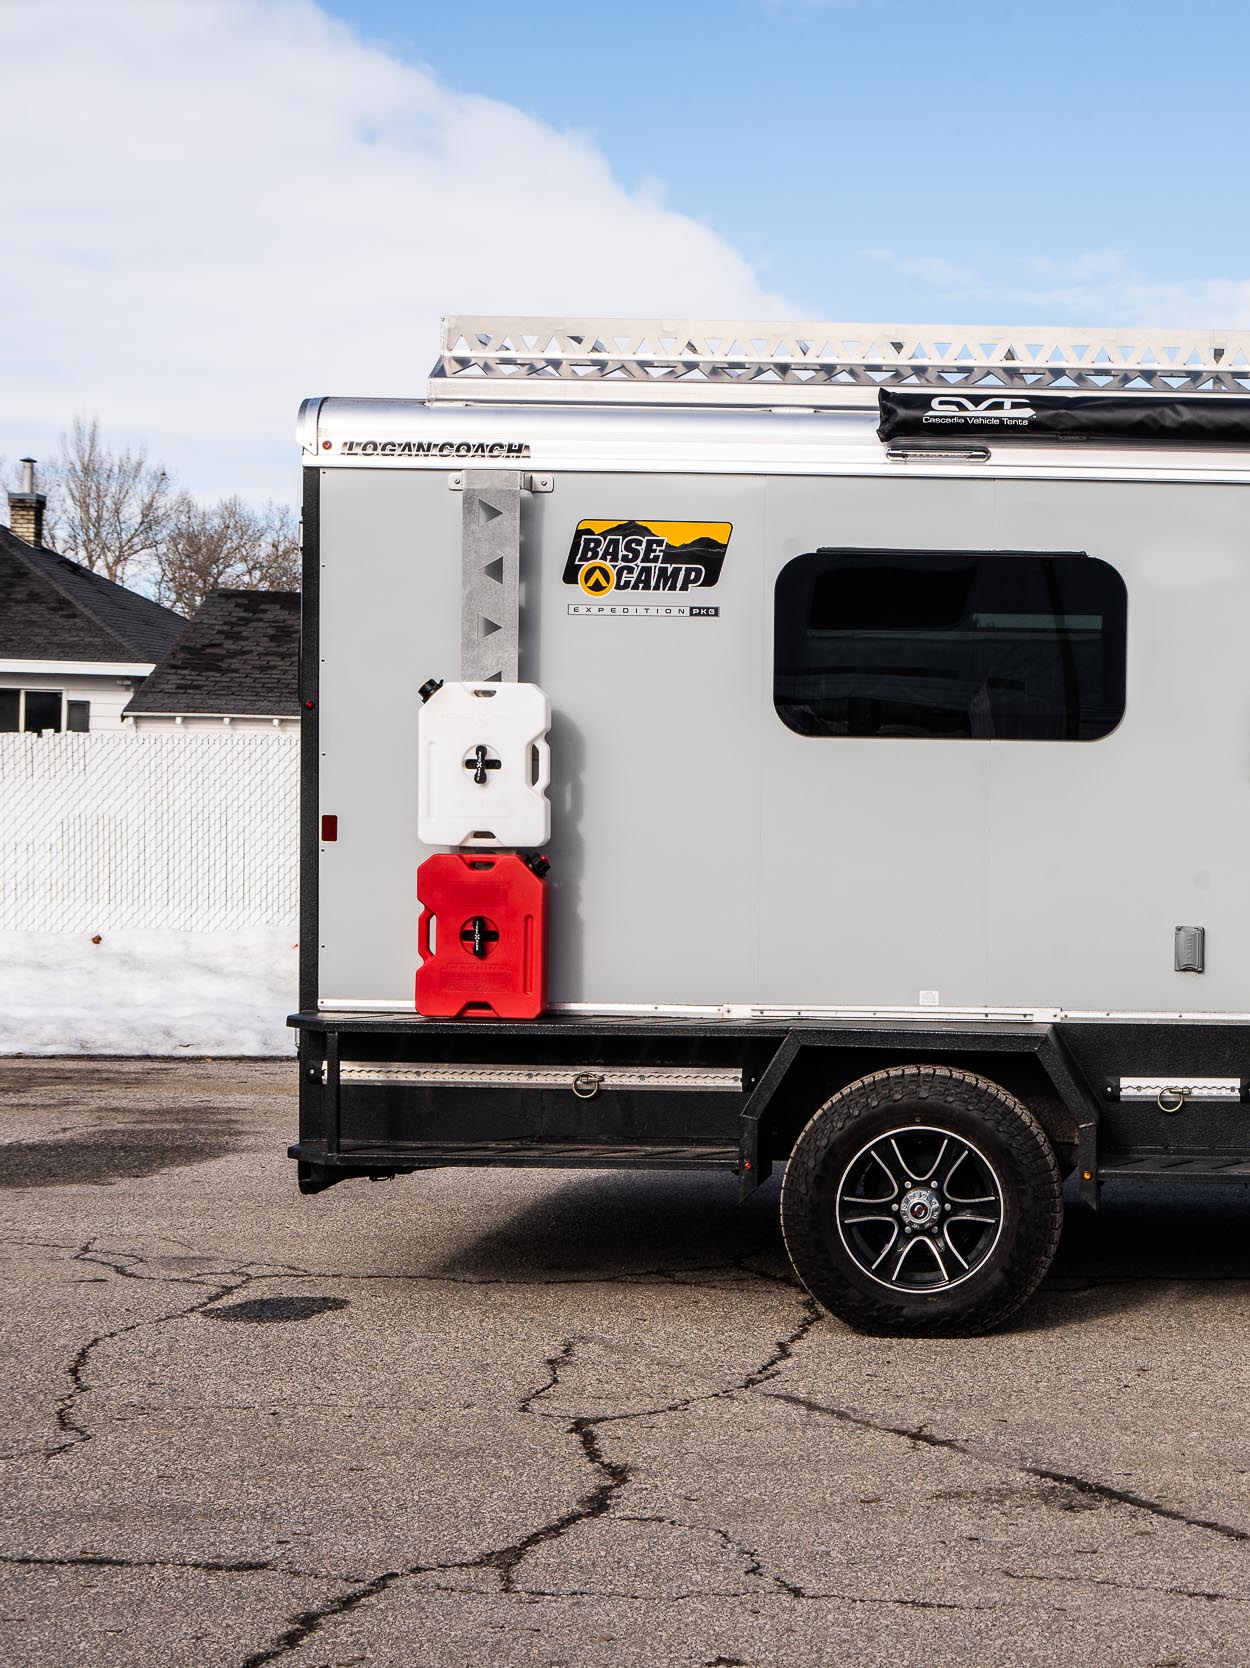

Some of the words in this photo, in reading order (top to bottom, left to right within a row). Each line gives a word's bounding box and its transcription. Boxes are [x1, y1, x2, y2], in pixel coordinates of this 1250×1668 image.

[922, 416, 965, 424] Cascadia
[966, 417, 1000, 425] Vehicle
[1002, 418, 1029, 426] Tents
[345, 440, 433, 457] LOGAN
[437, 441, 526, 458] COACH
[576, 536, 667, 564] BASE
[613, 564, 705, 592] CAMP
[573, 606, 686, 615] EXPEDITION
[692, 608, 716, 616] PKG
